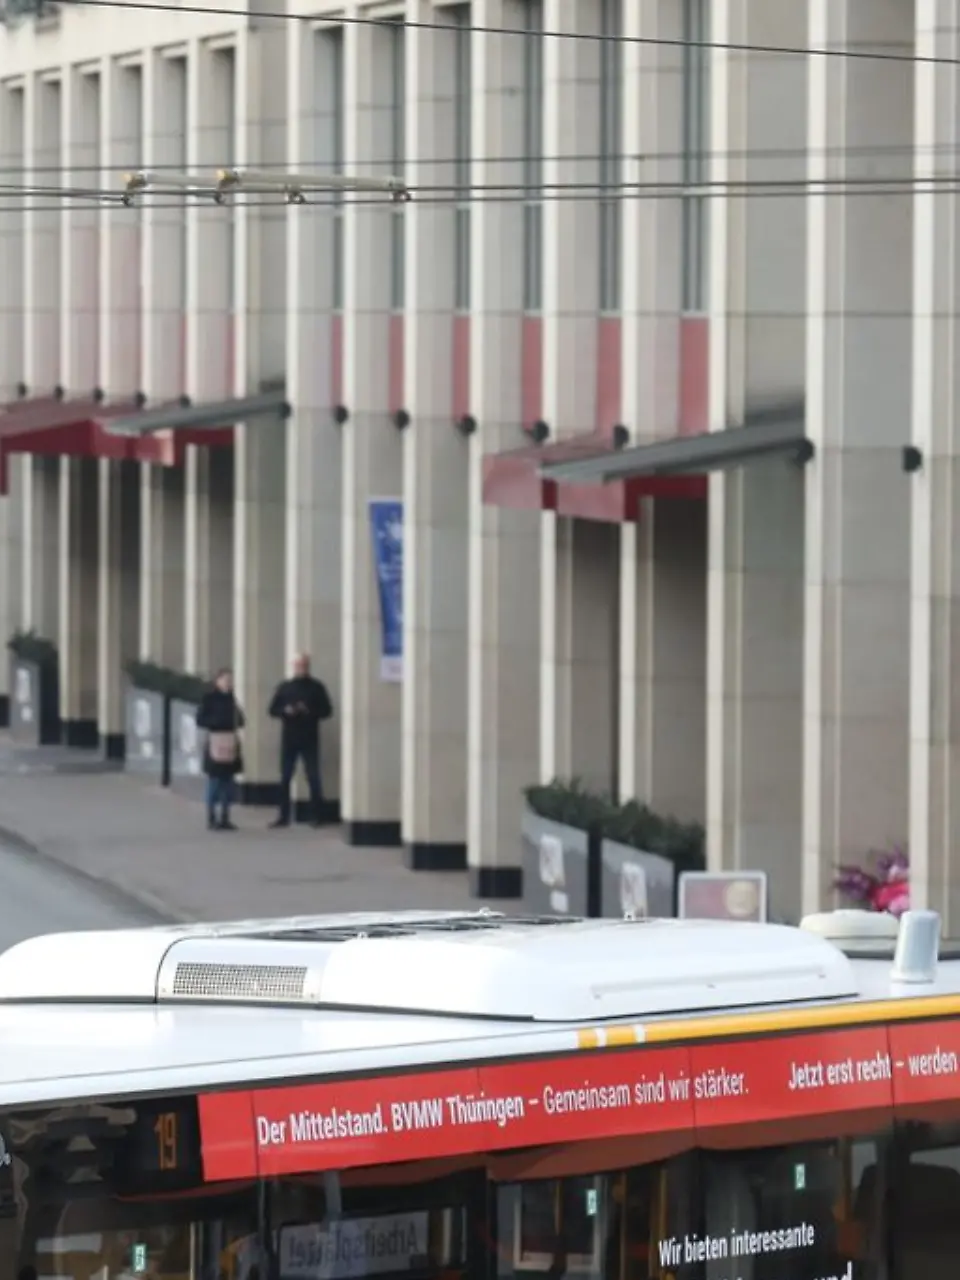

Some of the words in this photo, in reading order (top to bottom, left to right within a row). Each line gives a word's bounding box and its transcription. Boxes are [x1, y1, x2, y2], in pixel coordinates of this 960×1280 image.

[789, 1060, 824, 1090] Jetzt
[826, 1057, 854, 1085] erst
[857, 1050, 892, 1081] recht
[908, 1045, 958, 1076] werden
[257, 1116, 285, 1145] Der
[290, 1104, 388, 1143] Mittelstand.
[391, 1099, 443, 1132] BVMW
[447, 1092, 524, 1128] Thüringen
[543, 1078, 630, 1115] Gemeinsam
[635, 1073, 665, 1105] sind
[668, 1071, 690, 1099] wir
[694, 1069, 749, 1099] stärker.
[154, 1111, 177, 1171] 19
[660, 1237, 681, 1267] Wir
[685, 1235, 728, 1263] bieten
[731, 1222, 815, 1256] interessante
